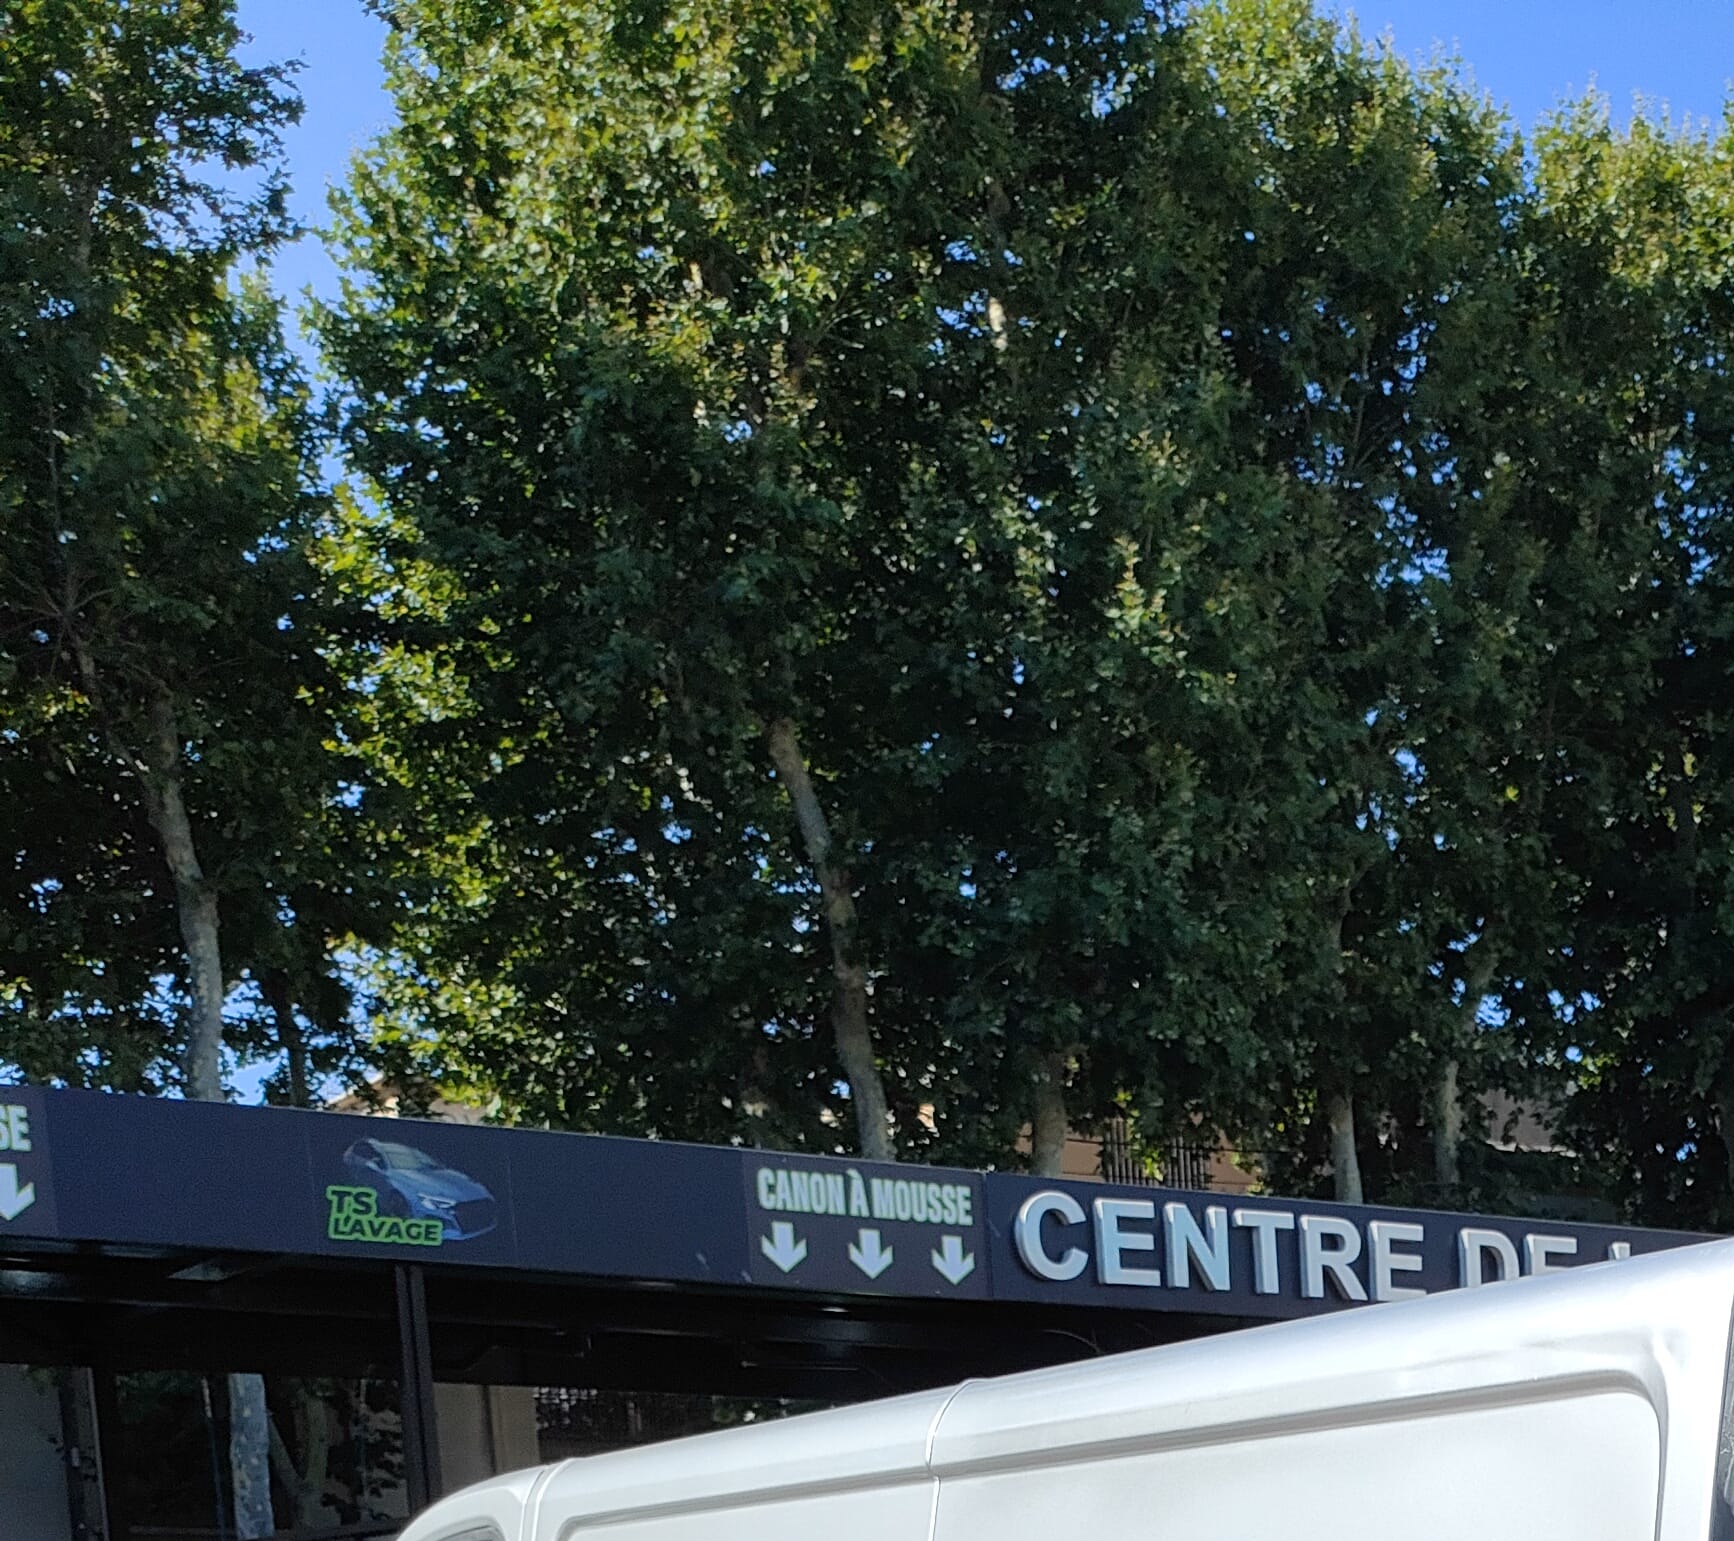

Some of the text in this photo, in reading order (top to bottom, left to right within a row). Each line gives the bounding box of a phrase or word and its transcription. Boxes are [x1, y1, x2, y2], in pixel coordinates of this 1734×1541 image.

[329, 1189, 375, 1217] TS
[756, 1167, 974, 1227] CANON À MOUSSE
[1014, 1189, 1428, 1302] CENTRE
